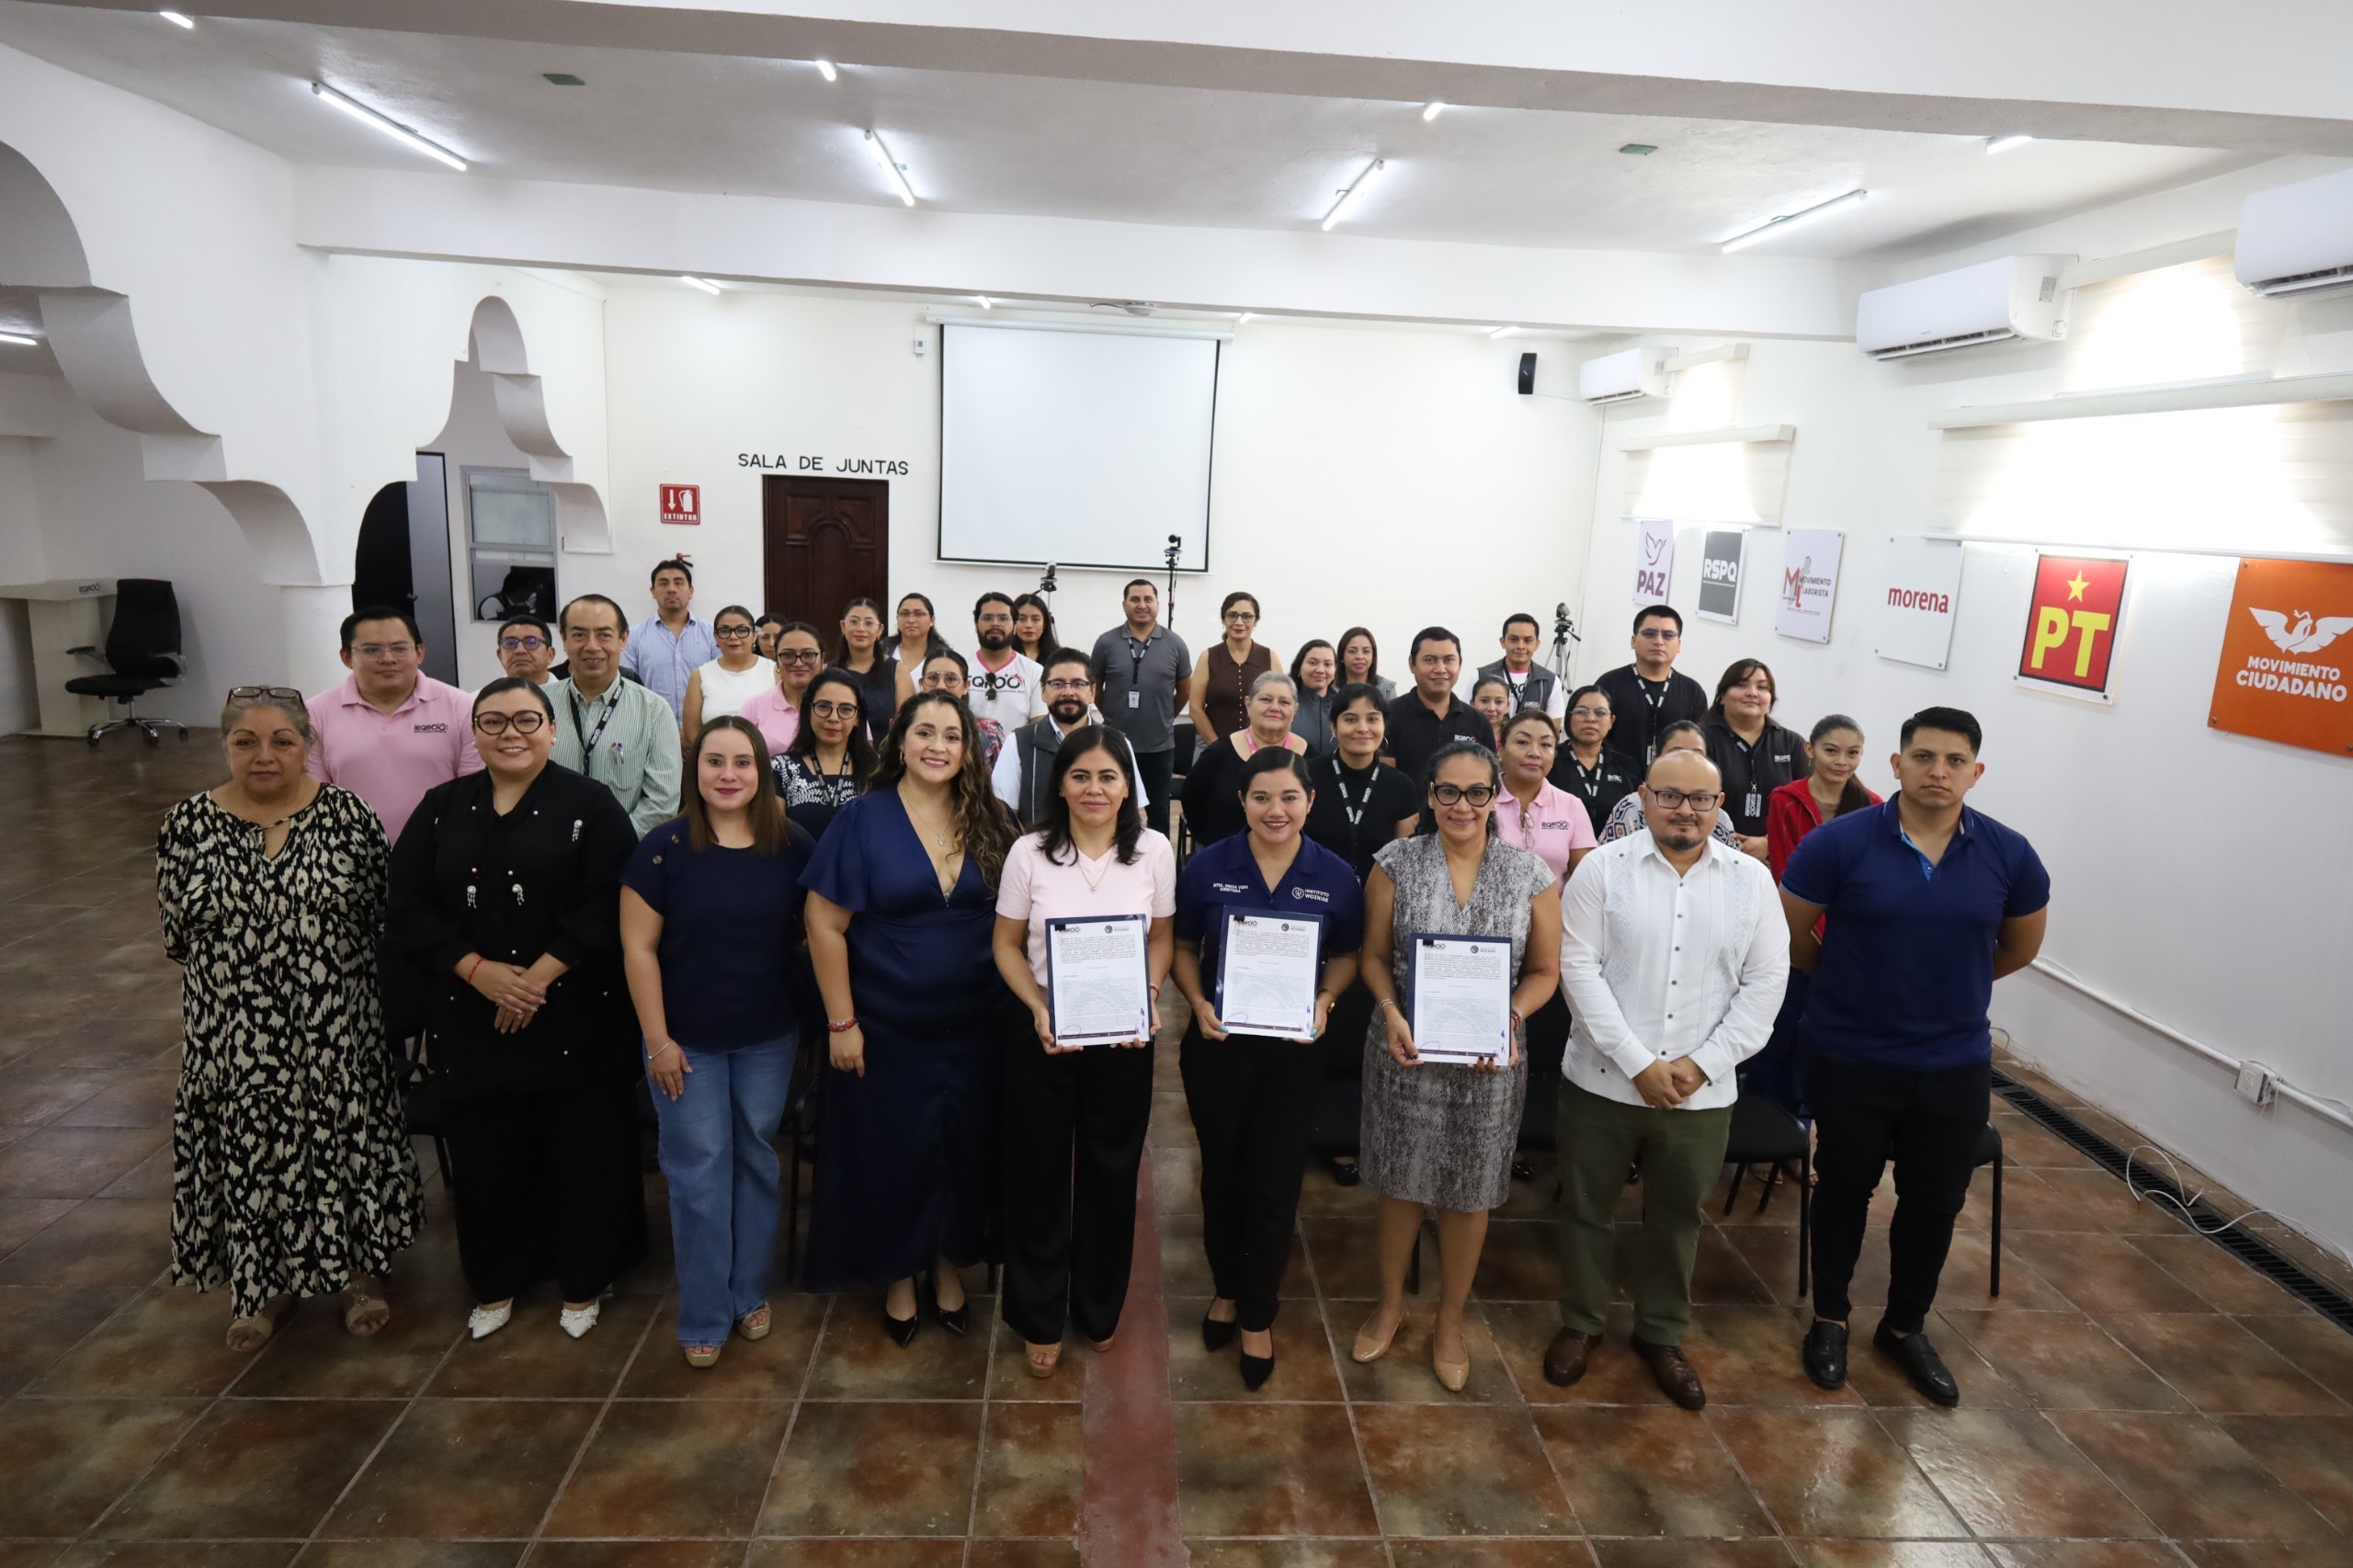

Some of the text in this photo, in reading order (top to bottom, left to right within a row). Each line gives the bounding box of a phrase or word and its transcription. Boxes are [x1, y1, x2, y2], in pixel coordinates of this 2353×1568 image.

[738, 453, 909, 475] SALA DE JUNTAS
[664, 513, 698, 521] EXTINTOR
[1636, 570, 1666, 597] PAZ
[1703, 559, 1737, 583] RSPQ
[1802, 587, 1829, 598] LABORISTA
[1887, 587, 1949, 614] morena
[2030, 606, 2111, 678] PT
[2246, 655, 2341, 681] MOVIMIENTO
[2235, 669, 2347, 702] CIUDADANO
[1304, 893, 1329, 903] WOZNIAK
